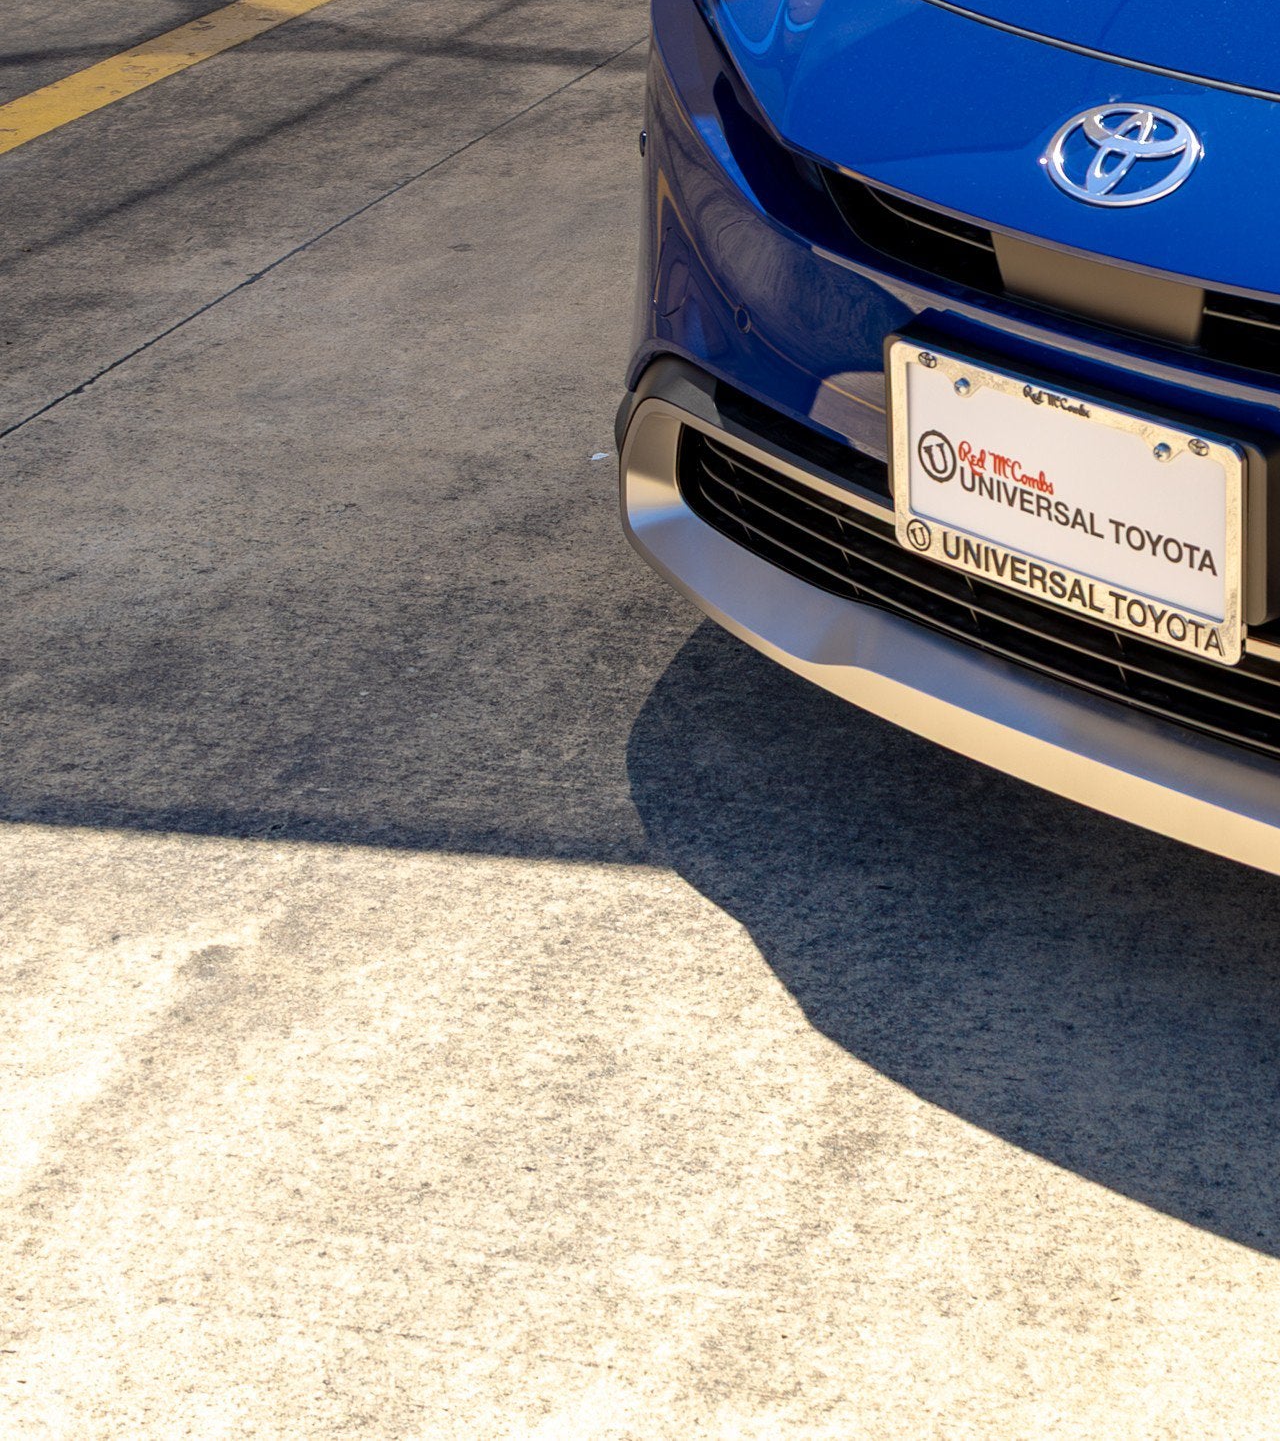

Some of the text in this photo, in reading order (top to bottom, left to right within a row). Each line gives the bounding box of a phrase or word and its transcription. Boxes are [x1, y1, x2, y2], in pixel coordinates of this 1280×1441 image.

[1023, 384, 1043, 405] Red
[958, 440, 1054, 495] Red McCombs
[960, 465, 1219, 577] UNIVERSAL TOYOTA
[942, 531, 1226, 657] UNIVERSAL TOYOTA
